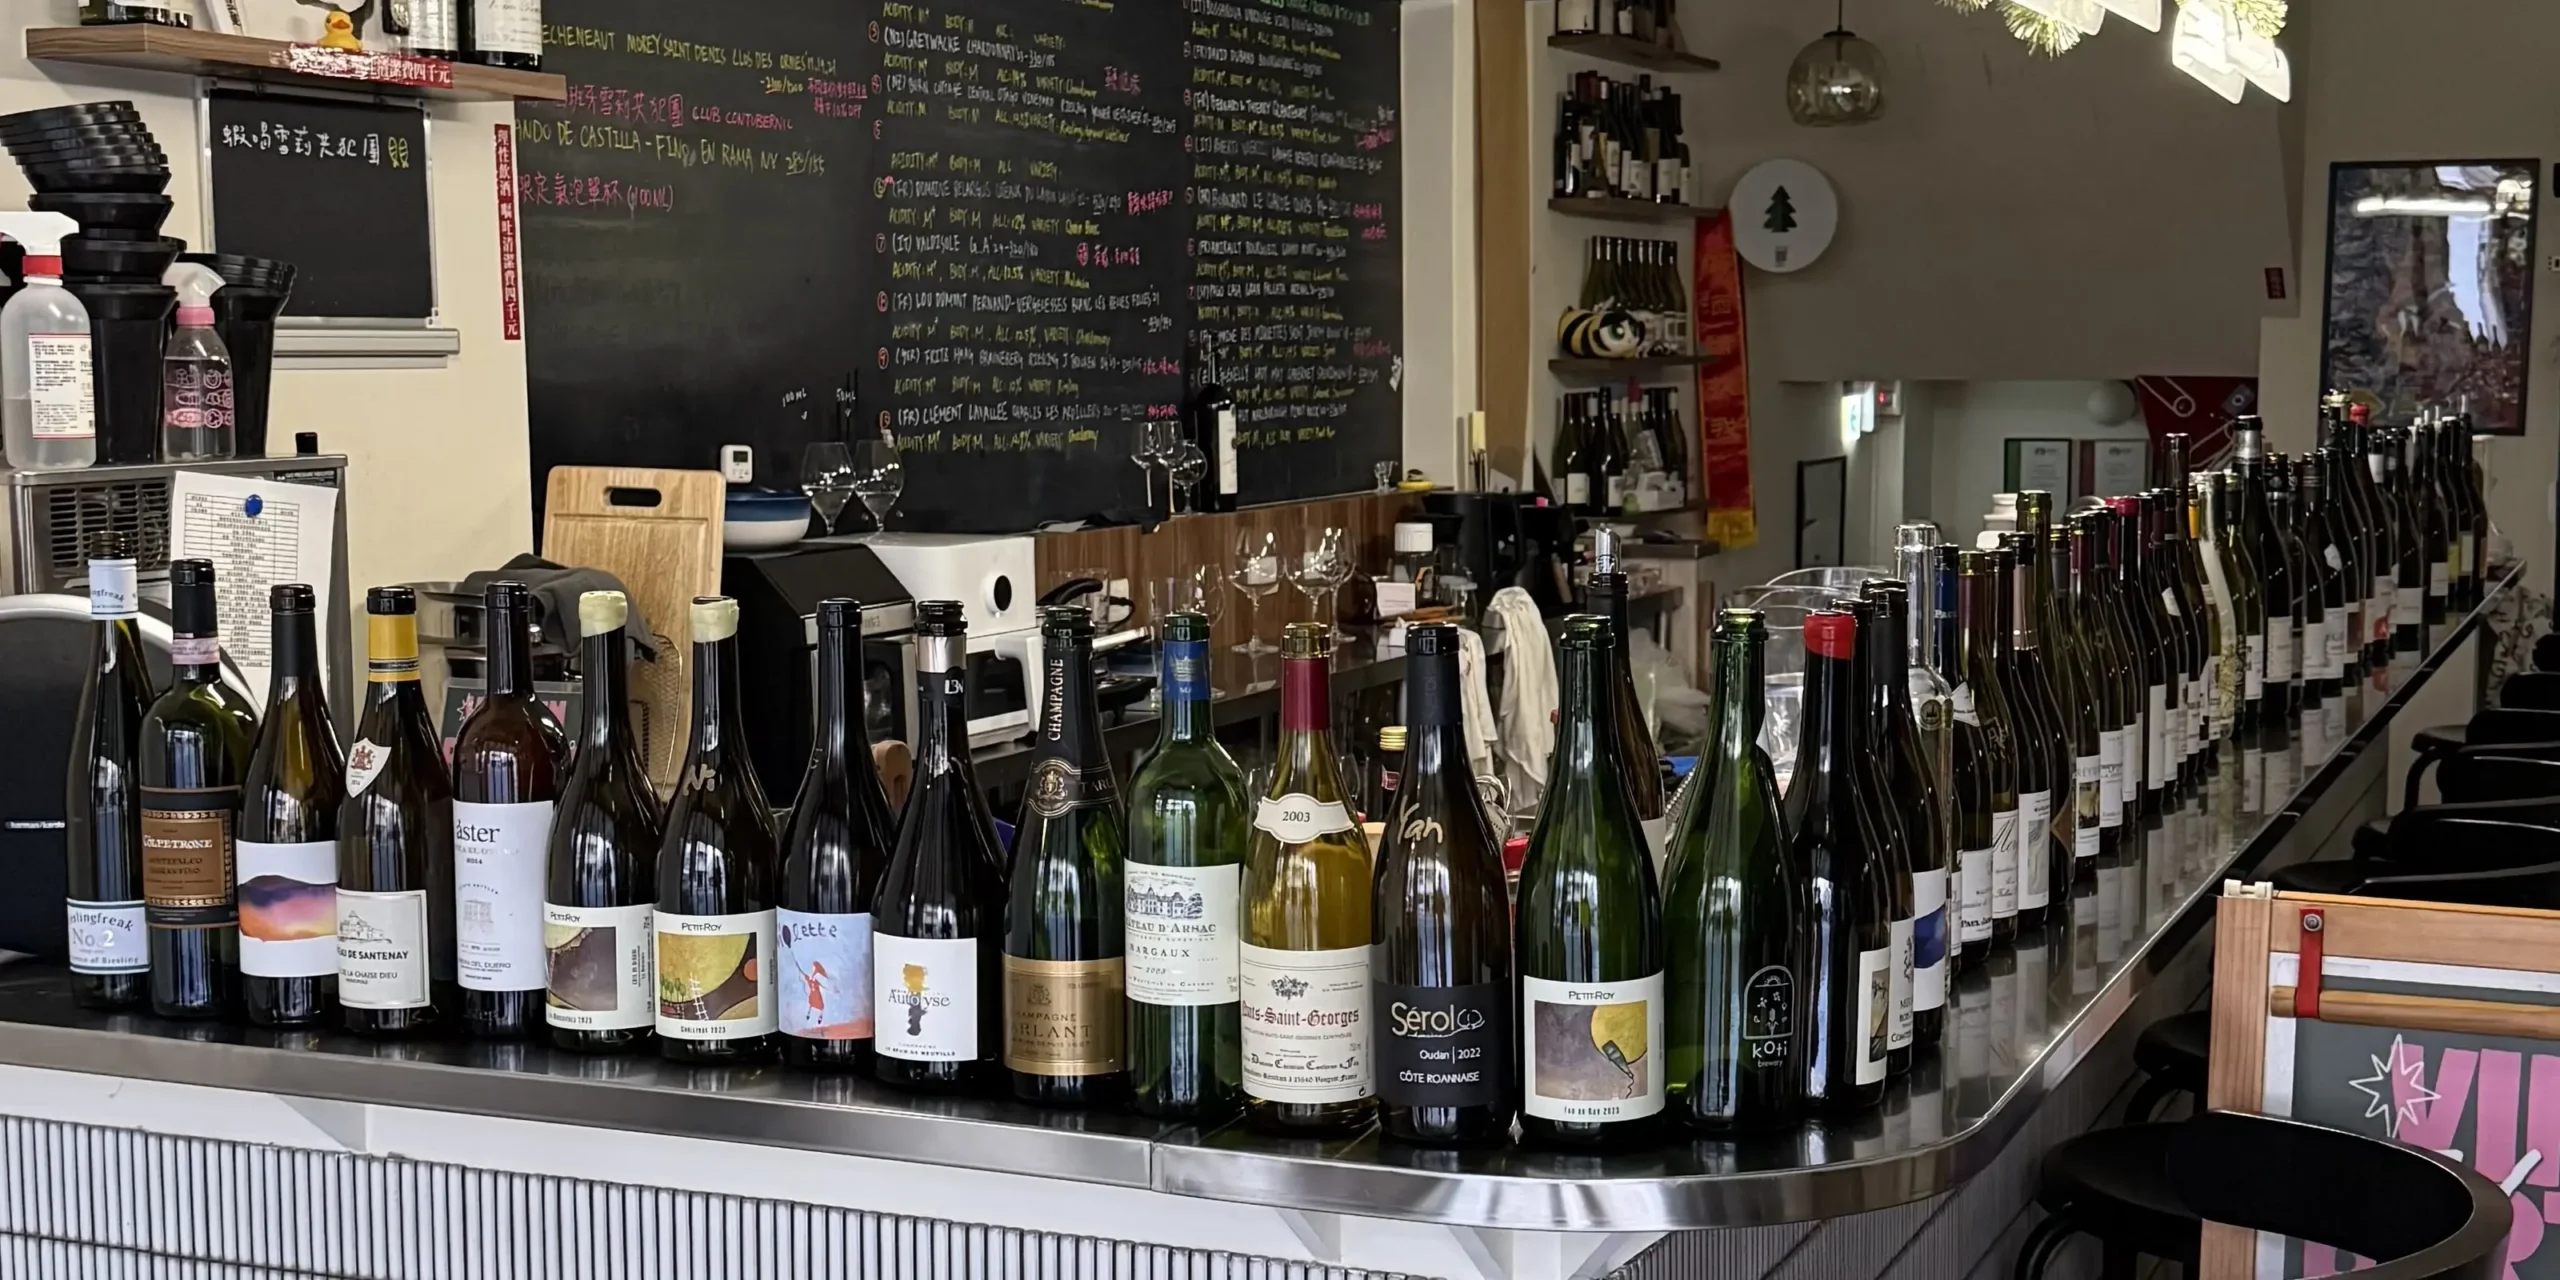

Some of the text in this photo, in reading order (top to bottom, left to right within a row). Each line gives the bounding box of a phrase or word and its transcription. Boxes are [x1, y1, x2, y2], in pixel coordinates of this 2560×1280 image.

[692, 106, 721, 122] CLUB
[557, 119, 574, 145] DE
[580, 124, 642, 153] CASTILLA
[701, 138, 715, 165] EN
[722, 143, 754, 174] RAMA
[496, 128, 513, 199] 理性飲酒
[1047, 657, 1064, 741] CHAMPAGNE
[1282, 810, 1311, 823] 2003
[358, 950, 409, 961] SANTENAY
[379, 970, 398, 979] DIEU
[1391, 1001, 1455, 1036] Sérol
[1419, 1048, 1481, 1060] Oudan 2022
[1399, 1069, 1480, 1084] CÔTE ROANNAISE
